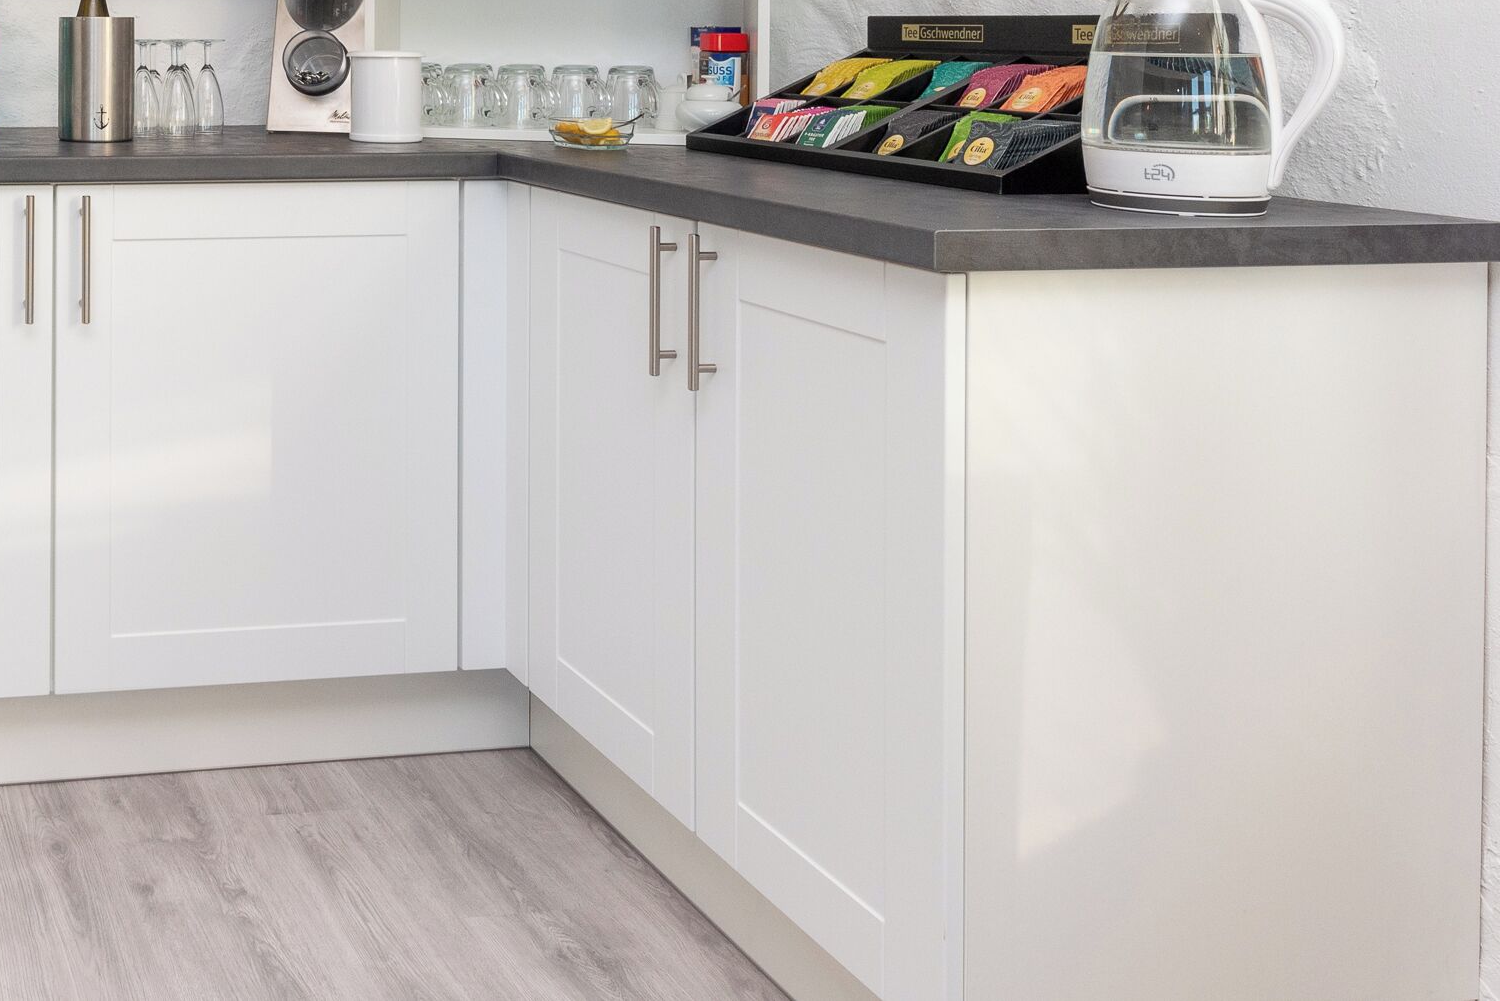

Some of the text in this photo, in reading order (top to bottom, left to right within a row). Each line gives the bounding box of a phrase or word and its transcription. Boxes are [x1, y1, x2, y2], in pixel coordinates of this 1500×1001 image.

[903, 26, 981, 40] Tee Gschwendner
[1074, 27, 1093, 41] Tee
